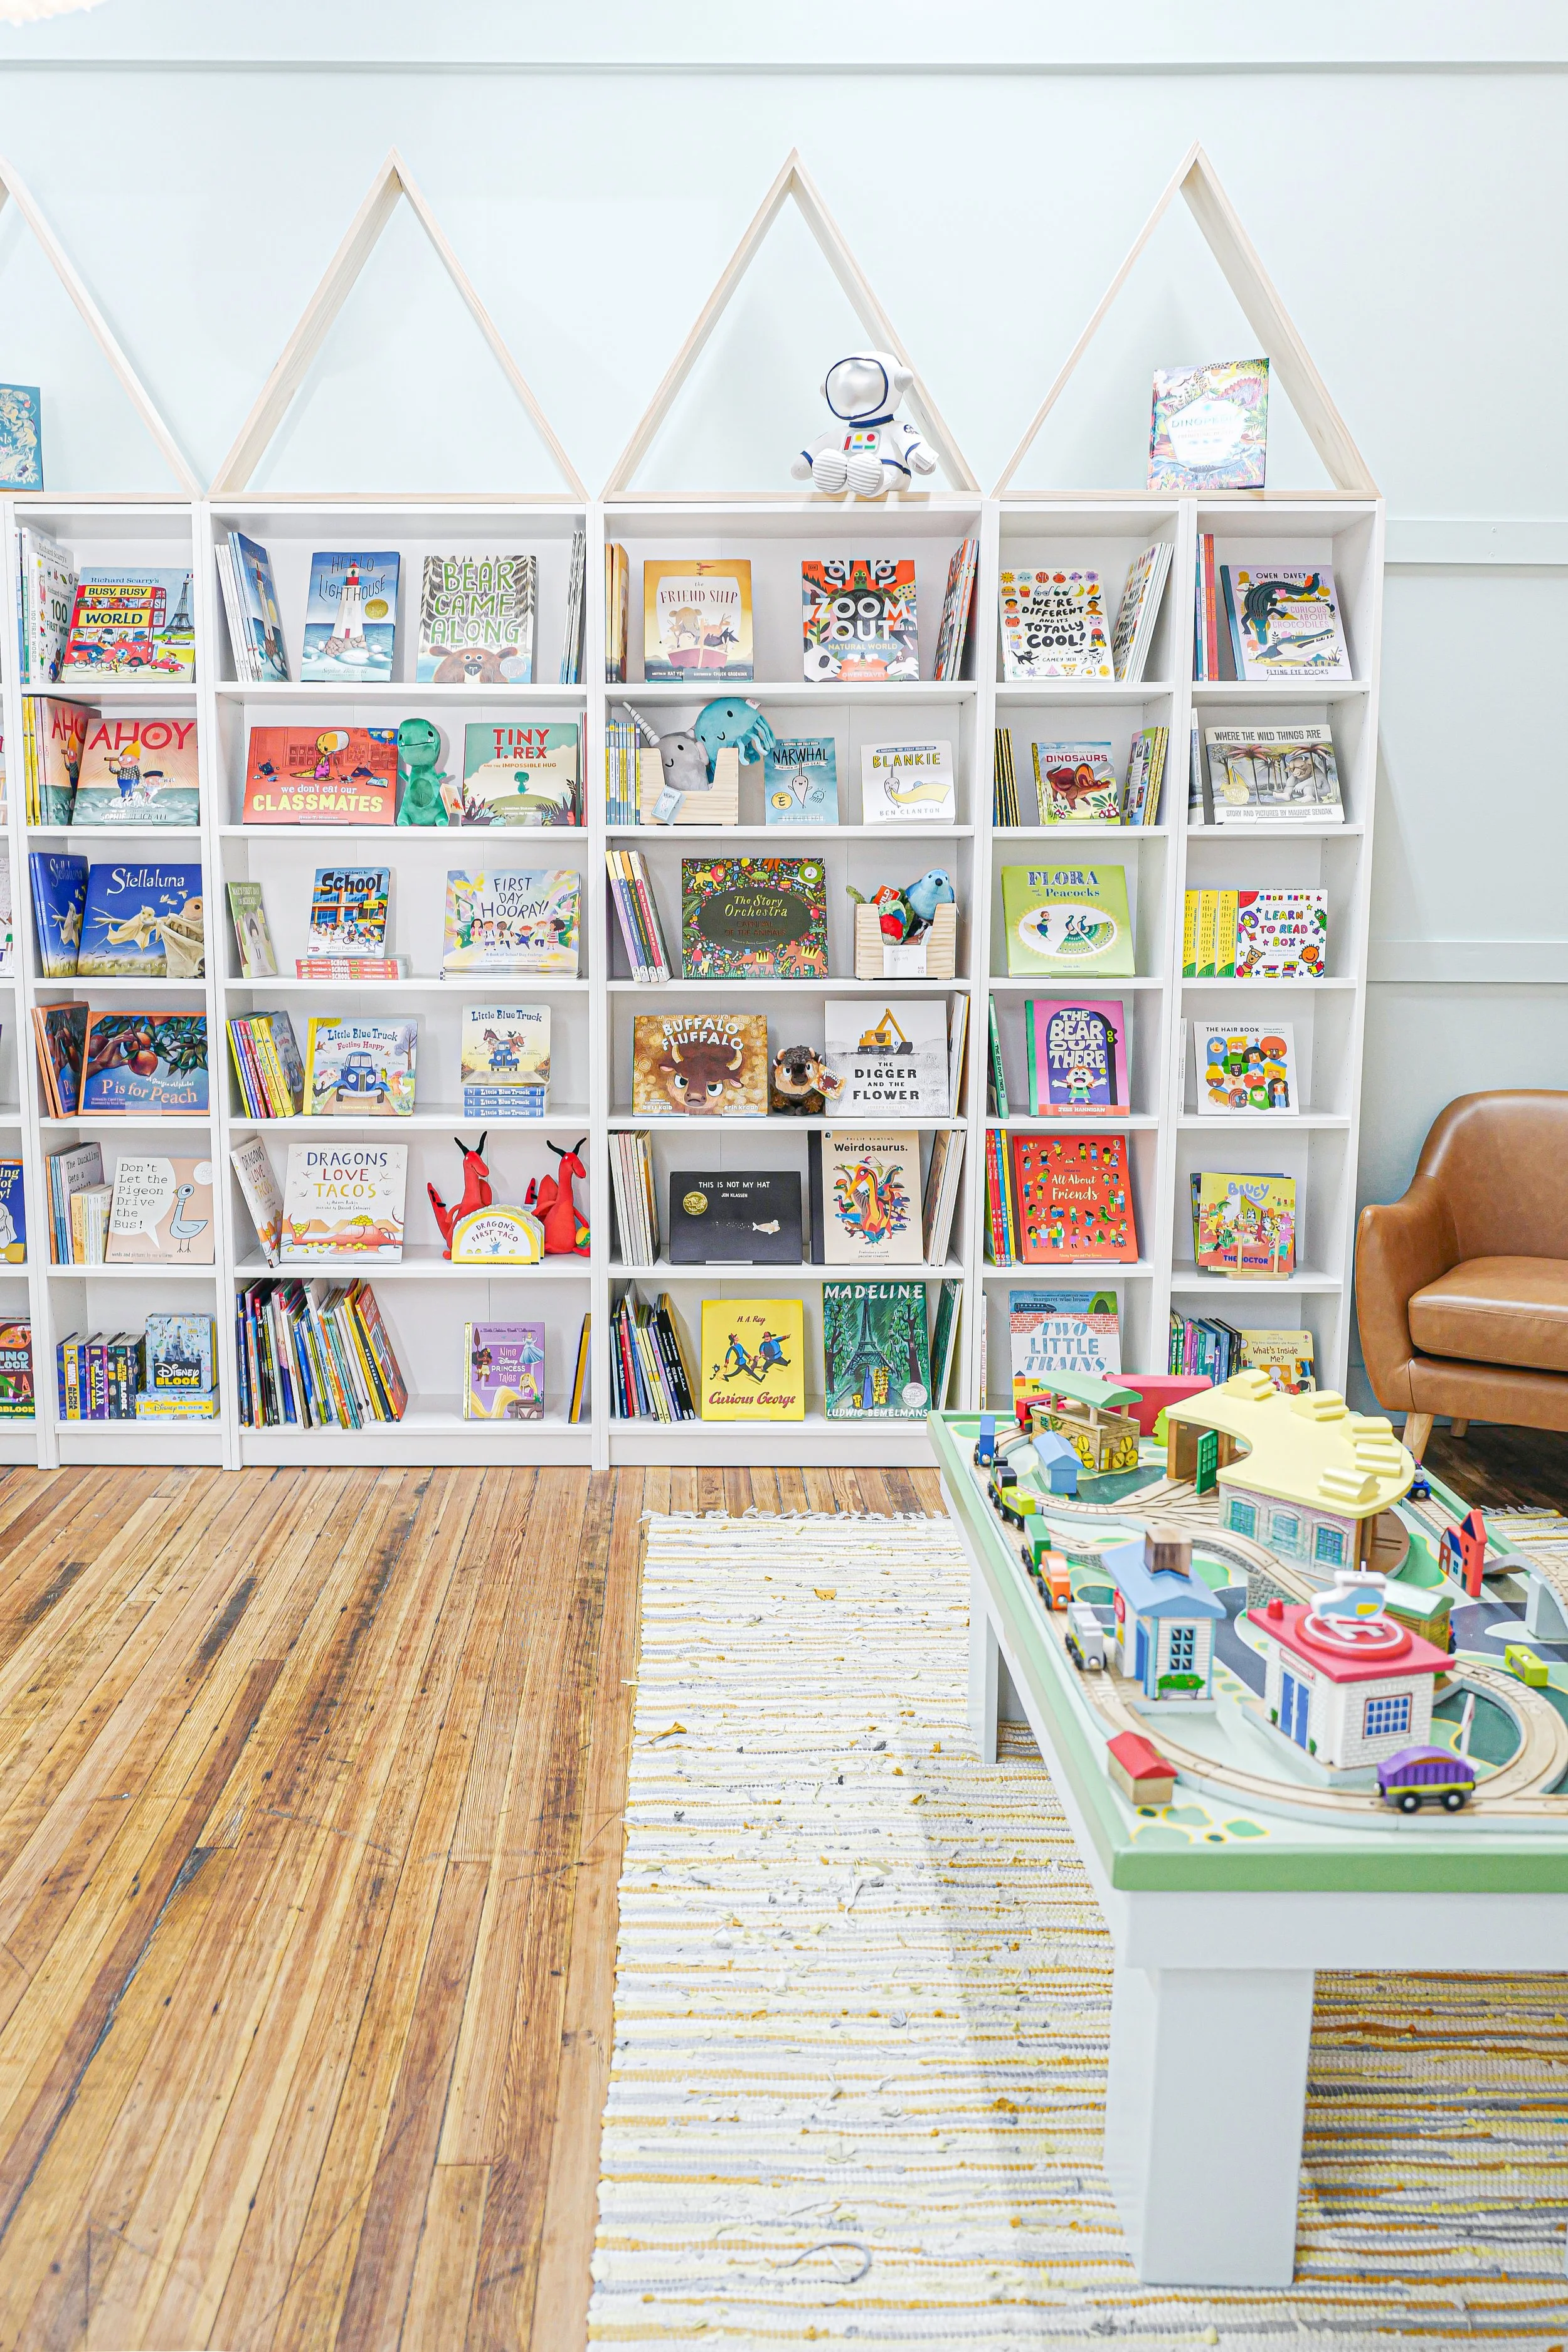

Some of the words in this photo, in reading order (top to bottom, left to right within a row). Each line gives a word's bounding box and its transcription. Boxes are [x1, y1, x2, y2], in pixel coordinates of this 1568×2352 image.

[331, 554, 374, 573] HELLO
[443, 562, 515, 593] BEAR
[88, 588, 117, 596] BUSY,
[319, 575, 386, 602] LIGHTHOUSE
[661, 590, 705, 603] FRIEND
[710, 590, 738, 603] SHIP
[1032, 597, 1074, 607] WE'RE
[51, 598, 68, 623] 100
[435, 593, 516, 617] CAME
[815, 597, 908, 618] ZOOM
[1022, 606, 1084, 617] DIFFERENT
[86, 612, 142, 625] WORLD
[430, 618, 519, 645] ALONG
[832, 620, 893, 641] OUT
[1025, 621, 1084, 633] TOTALLY
[1027, 632, 1086, 649] COOL!
[493, 728, 549, 745] TINY
[1214, 732, 1240, 741] WHERE
[1241, 732, 1254, 740] THE
[1257, 732, 1274, 741] WILD
[1276, 731, 1304, 740] THINGS
[1306, 729, 1321, 739] ARE
[494, 746, 508, 759] T.
[514, 746, 547, 759] REX
[773, 748, 829, 765] NARWHAL
[1046, 755, 1108, 763] DINOSAURS
[872, 753, 941, 768] BLANKIE
[297, 784, 319, 793] don't
[253, 794, 383, 812] CLASSMATES
[107, 868, 185, 896] Stellaluna
[320, 871, 383, 896] School
[494, 878, 532, 892] FIRST
[1027, 871, 1099, 886] FLORA
[1046, 888, 1099, 897] Peacocks
[734, 896, 751, 904] The
[753, 894, 783, 908] Story
[481, 900, 549, 919] HOORAY!
[724, 904, 787, 918] Orchestra
[1264, 910, 1303, 920] LEARN
[1259, 925, 1276, 934] TO
[1279, 924, 1308, 934] READ
[1273, 938, 1295, 947] BOX
[472, 1011, 494, 1021] Little
[497, 1010, 515, 1019] Blue
[516, 1010, 542, 1022] Truck
[1060, 1011, 1089, 1021] THE
[662, 1017, 740, 1037] BUFFALO
[1050, 1020, 1104, 1041] BEAR
[327, 1029, 351, 1042] Little
[352, 1027, 371, 1038] Blue
[372, 1028, 398, 1042] Truck
[337, 1042, 361, 1051] Feeling
[363, 1041, 384, 1051] Happy
[662, 1031, 744, 1052] FLUFFALO
[1049, 1040, 1103, 1050] OUT
[1049, 1051, 1105, 1068] THERE
[854, 1069, 917, 1078] DIGGER
[102, 1079, 112, 1095] P
[115, 1084, 125, 1094] is
[128, 1083, 149, 1098] for
[149, 1086, 198, 1104] Peach
[853, 1091, 919, 1099] FLOWER
[834, 1143, 908, 1152] Weirdosaurus.
[307, 1152, 388, 1167] DRAGONS
[120, 1163, 157, 1173] Don't
[323, 1168, 369, 1181] LOVE
[119, 1175, 142, 1184] Let
[147, 1175, 167, 1184] the
[1051, 1174, 1066, 1185] All
[1068, 1174, 1096, 1185] About
[118, 1186, 163, 1195] Pigeon
[314, 1183, 376, 1198] TACOS
[1052, 1186, 1099, 1200] Friends
[1228, 1182, 1269, 1201] BLUEY
[117, 1197, 155, 1207] Drive
[116, 1208, 138, 1217] the
[114, 1220, 143, 1229] Bus!
[476, 1221, 515, 1232] DRAGON'S
[472, 1230, 494, 1242] FIRST
[497, 1230, 518, 1242] TACO
[1241, 1256, 1268, 1264] OCTOR
[824, 1285, 923, 1299] MADELINE
[753, 1316, 766, 1325] Rey
[1040, 1322, 1088, 1336] TWO
[500, 1348, 517, 1356] Nine
[1030, 1338, 1099, 1355] LITTLE
[1024, 1356, 1106, 1372] TRAINS
[67, 1363, 76, 1387] MARVEL
[156, 1377, 199, 1386] BLOCK
[499, 1373, 516, 1383] Tales
[709, 1392, 753, 1405] Curious
[757, 1392, 796, 1409] George
[827, 1409, 864, 1417] LUDWIG
[867, 1409, 928, 1417] BEMELMANS
